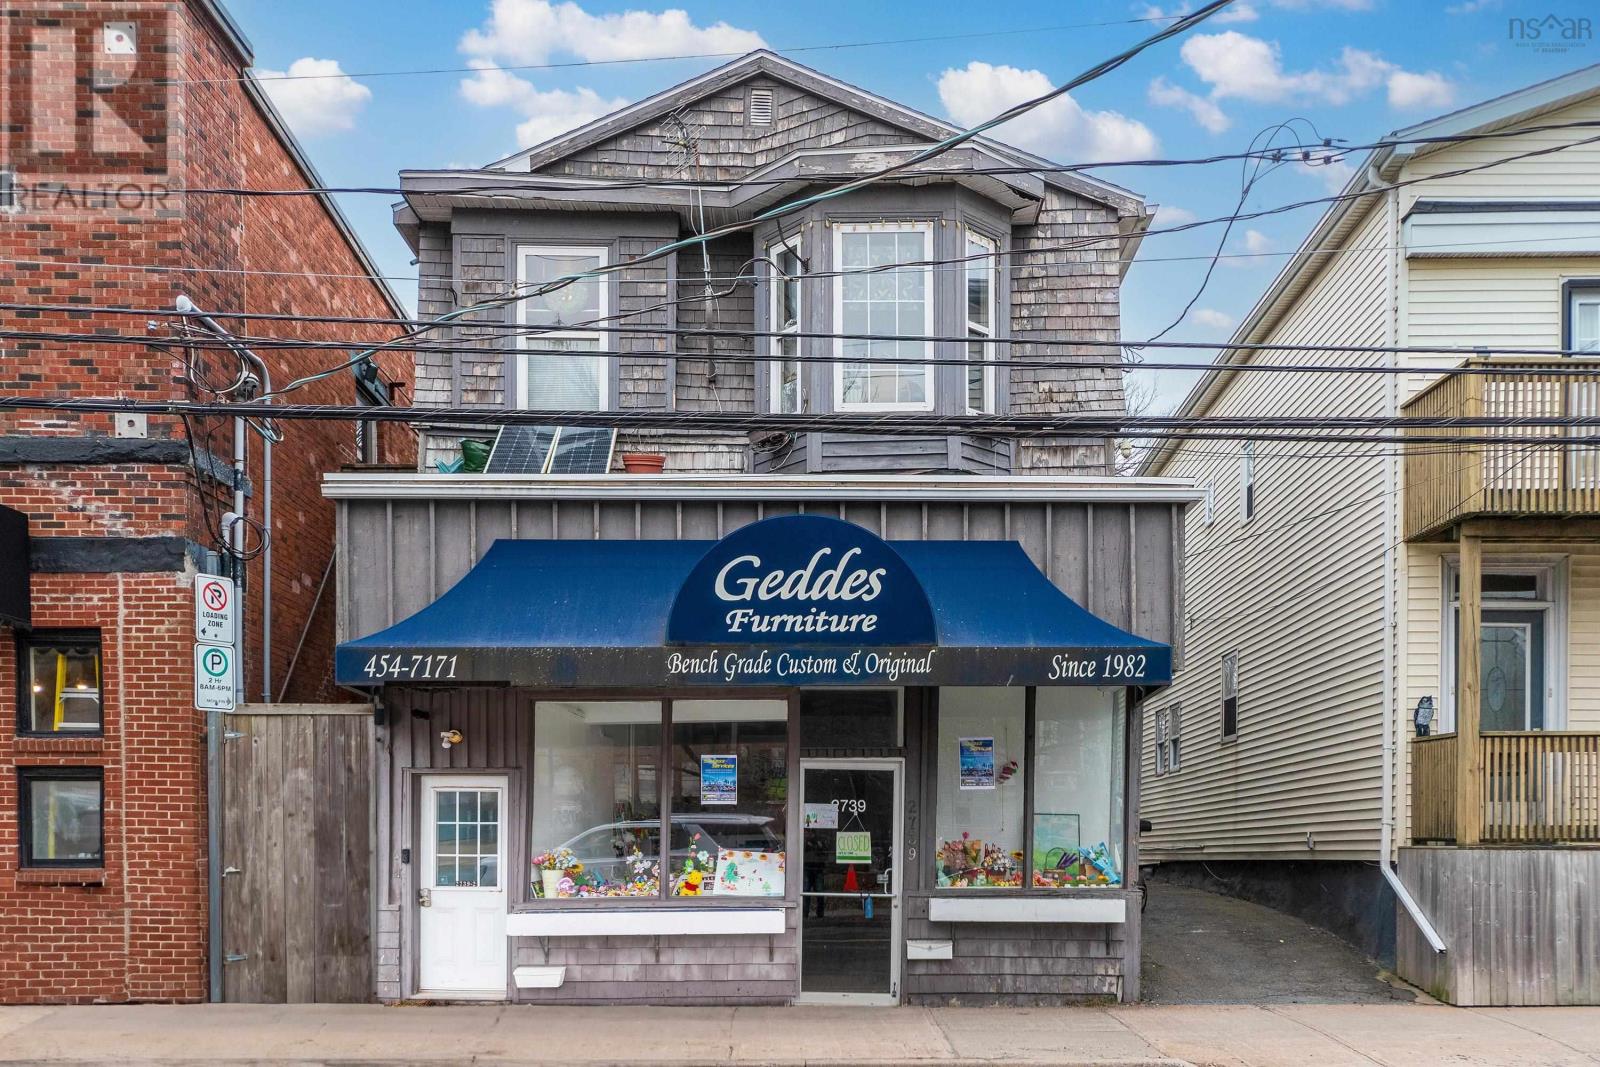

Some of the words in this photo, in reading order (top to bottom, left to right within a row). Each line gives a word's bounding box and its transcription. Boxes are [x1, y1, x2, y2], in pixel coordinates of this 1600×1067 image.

[714, 547, 887, 601] Geddes
[202, 611, 228, 620] LOADING
[207, 620, 224, 628] ZONE
[725, 607, 878, 633] Furniture
[363, 654, 458, 679] 454-7171
[667, 650, 718, 674] Bench
[723, 650, 772, 682] Grade
[776, 651, 837, 677] Custom
[842, 650, 862, 675] &
[865, 650, 936, 682] Original
[1048, 653, 1097, 680] Since
[1102, 654, 1146, 678] 1982
[838, 834, 870, 852] CLOSED
